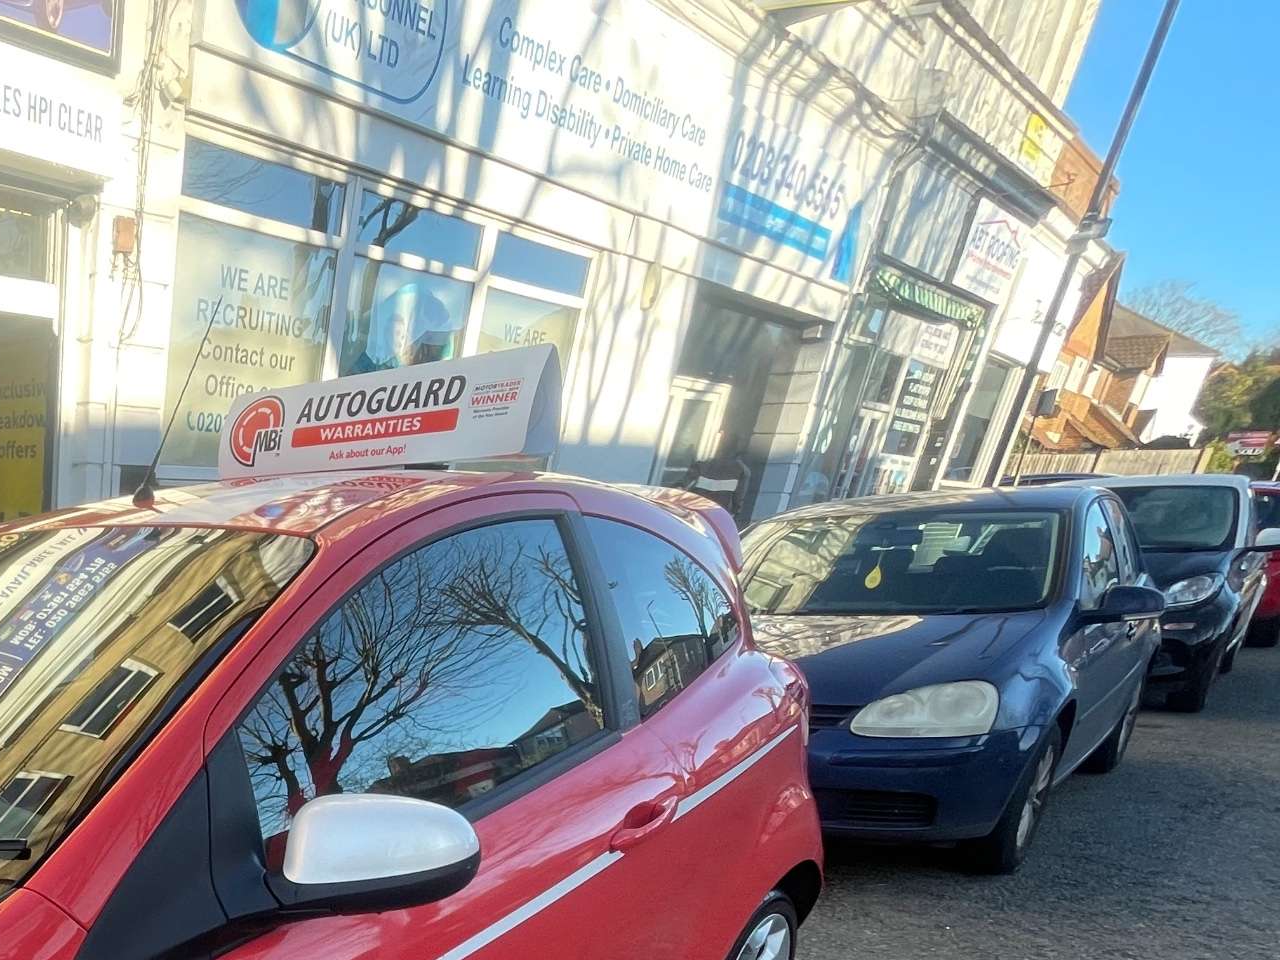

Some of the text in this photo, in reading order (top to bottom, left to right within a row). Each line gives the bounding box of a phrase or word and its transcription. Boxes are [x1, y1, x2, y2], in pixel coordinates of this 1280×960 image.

[324, 10, 400, 68] (UK) LTD
[499, 16, 706, 147] Complex Care Domiciliary Care
[27, 92, 54, 127] HPI
[58, 103, 104, 143] CLEAR
[462, 53, 713, 194] Learning Disability Private Home Care
[220, 263, 290, 301] WE ARE
[196, 298, 304, 338] RECRUITING
[504, 322, 548, 346] WE ARE
[200, 336, 296, 372] Contact our
[204, 373, 254, 399] Office
[295, 374, 468, 425] AUTOGUARD
[471, 391, 518, 406] WINNER
[253, 429, 283, 452] MBi
[320, 416, 422, 442] WARRANTIES
[329, 443, 407, 461] Ask about our App!
